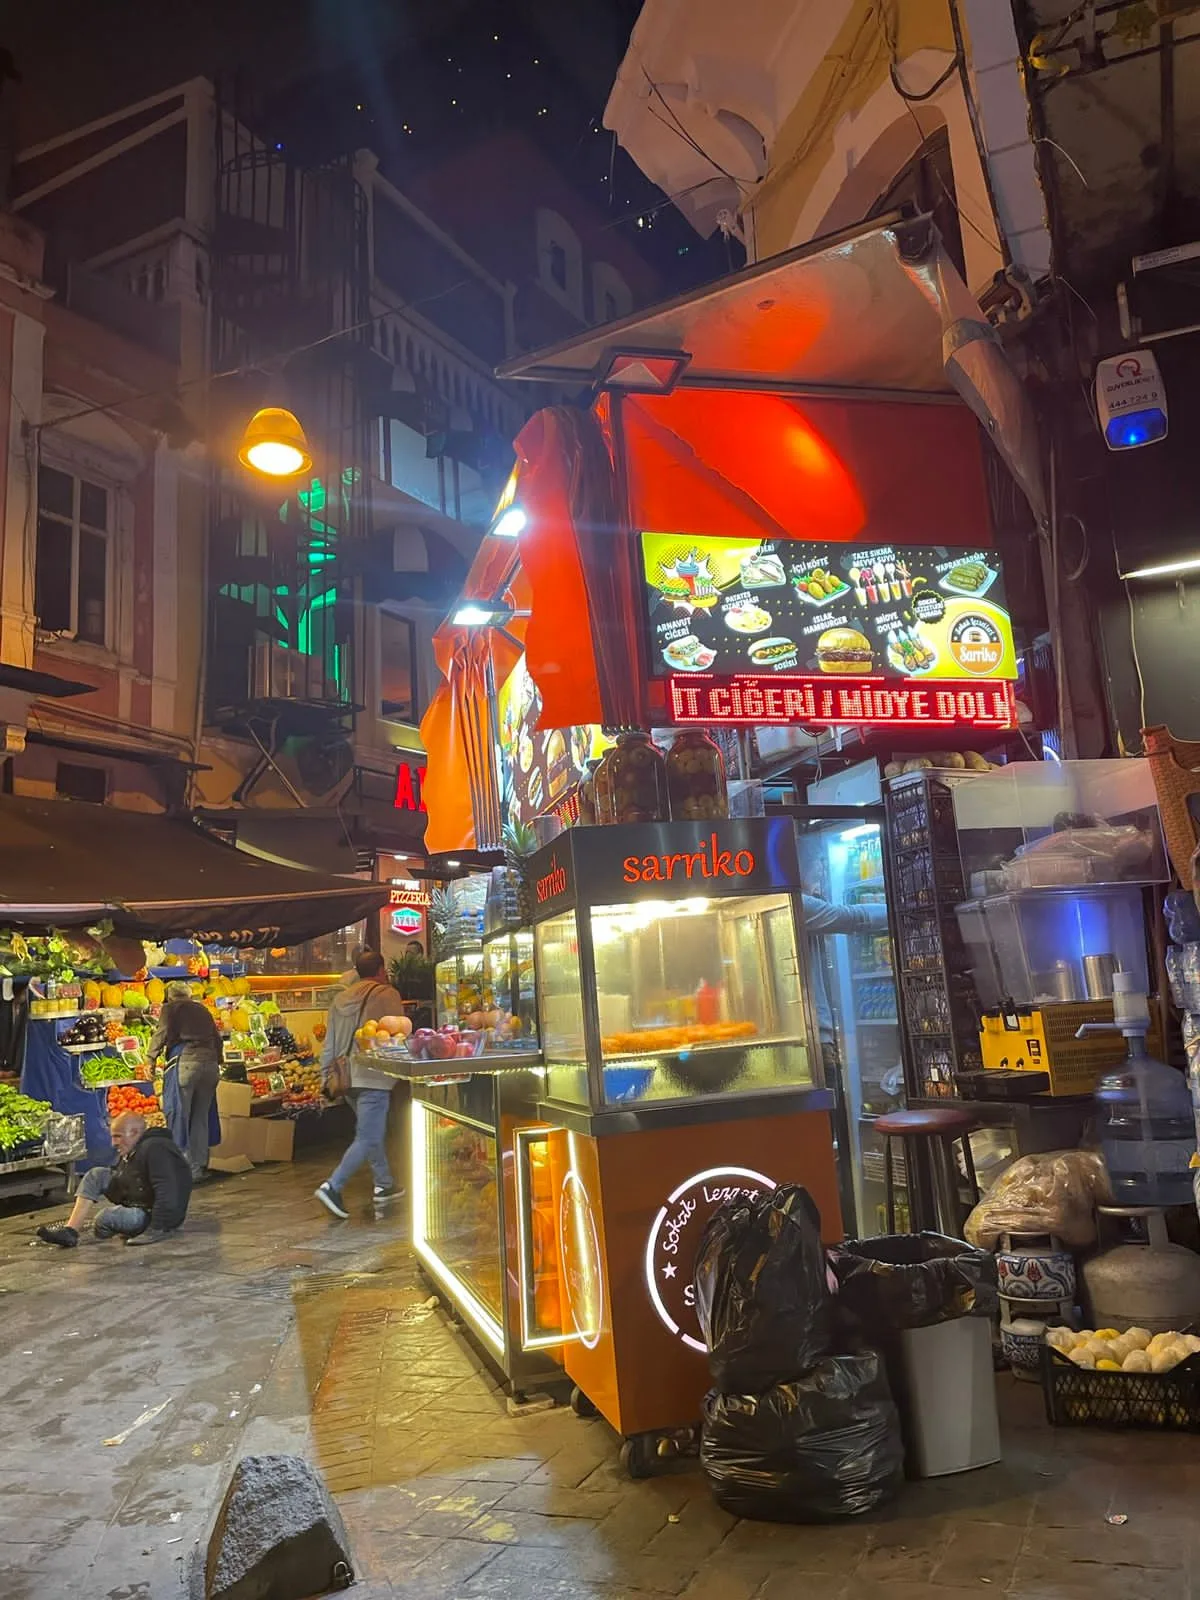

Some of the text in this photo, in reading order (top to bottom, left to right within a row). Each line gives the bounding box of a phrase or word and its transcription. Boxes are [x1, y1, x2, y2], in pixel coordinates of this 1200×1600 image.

[807, 557, 830, 569] KÖFTE
[852, 551, 870, 561] TAZE
[724, 591, 751, 605] PATATES
[656, 617, 692, 633] ARNAVUT
[803, 616, 848, 635] HAMBURGER
[876, 611, 899, 624] MİDYE
[664, 626, 690, 640] CİĞERİ
[877, 620, 903, 634] DOLMA
[709, 680, 816, 717] CİĞERİ
[838, 685, 931, 718] MİDYE
[623, 832, 756, 883] sarriko
[536, 852, 566, 903] sarriko
[390, 890, 432, 906] PIZZERIA
[663, 1198, 697, 1255] Sokak
